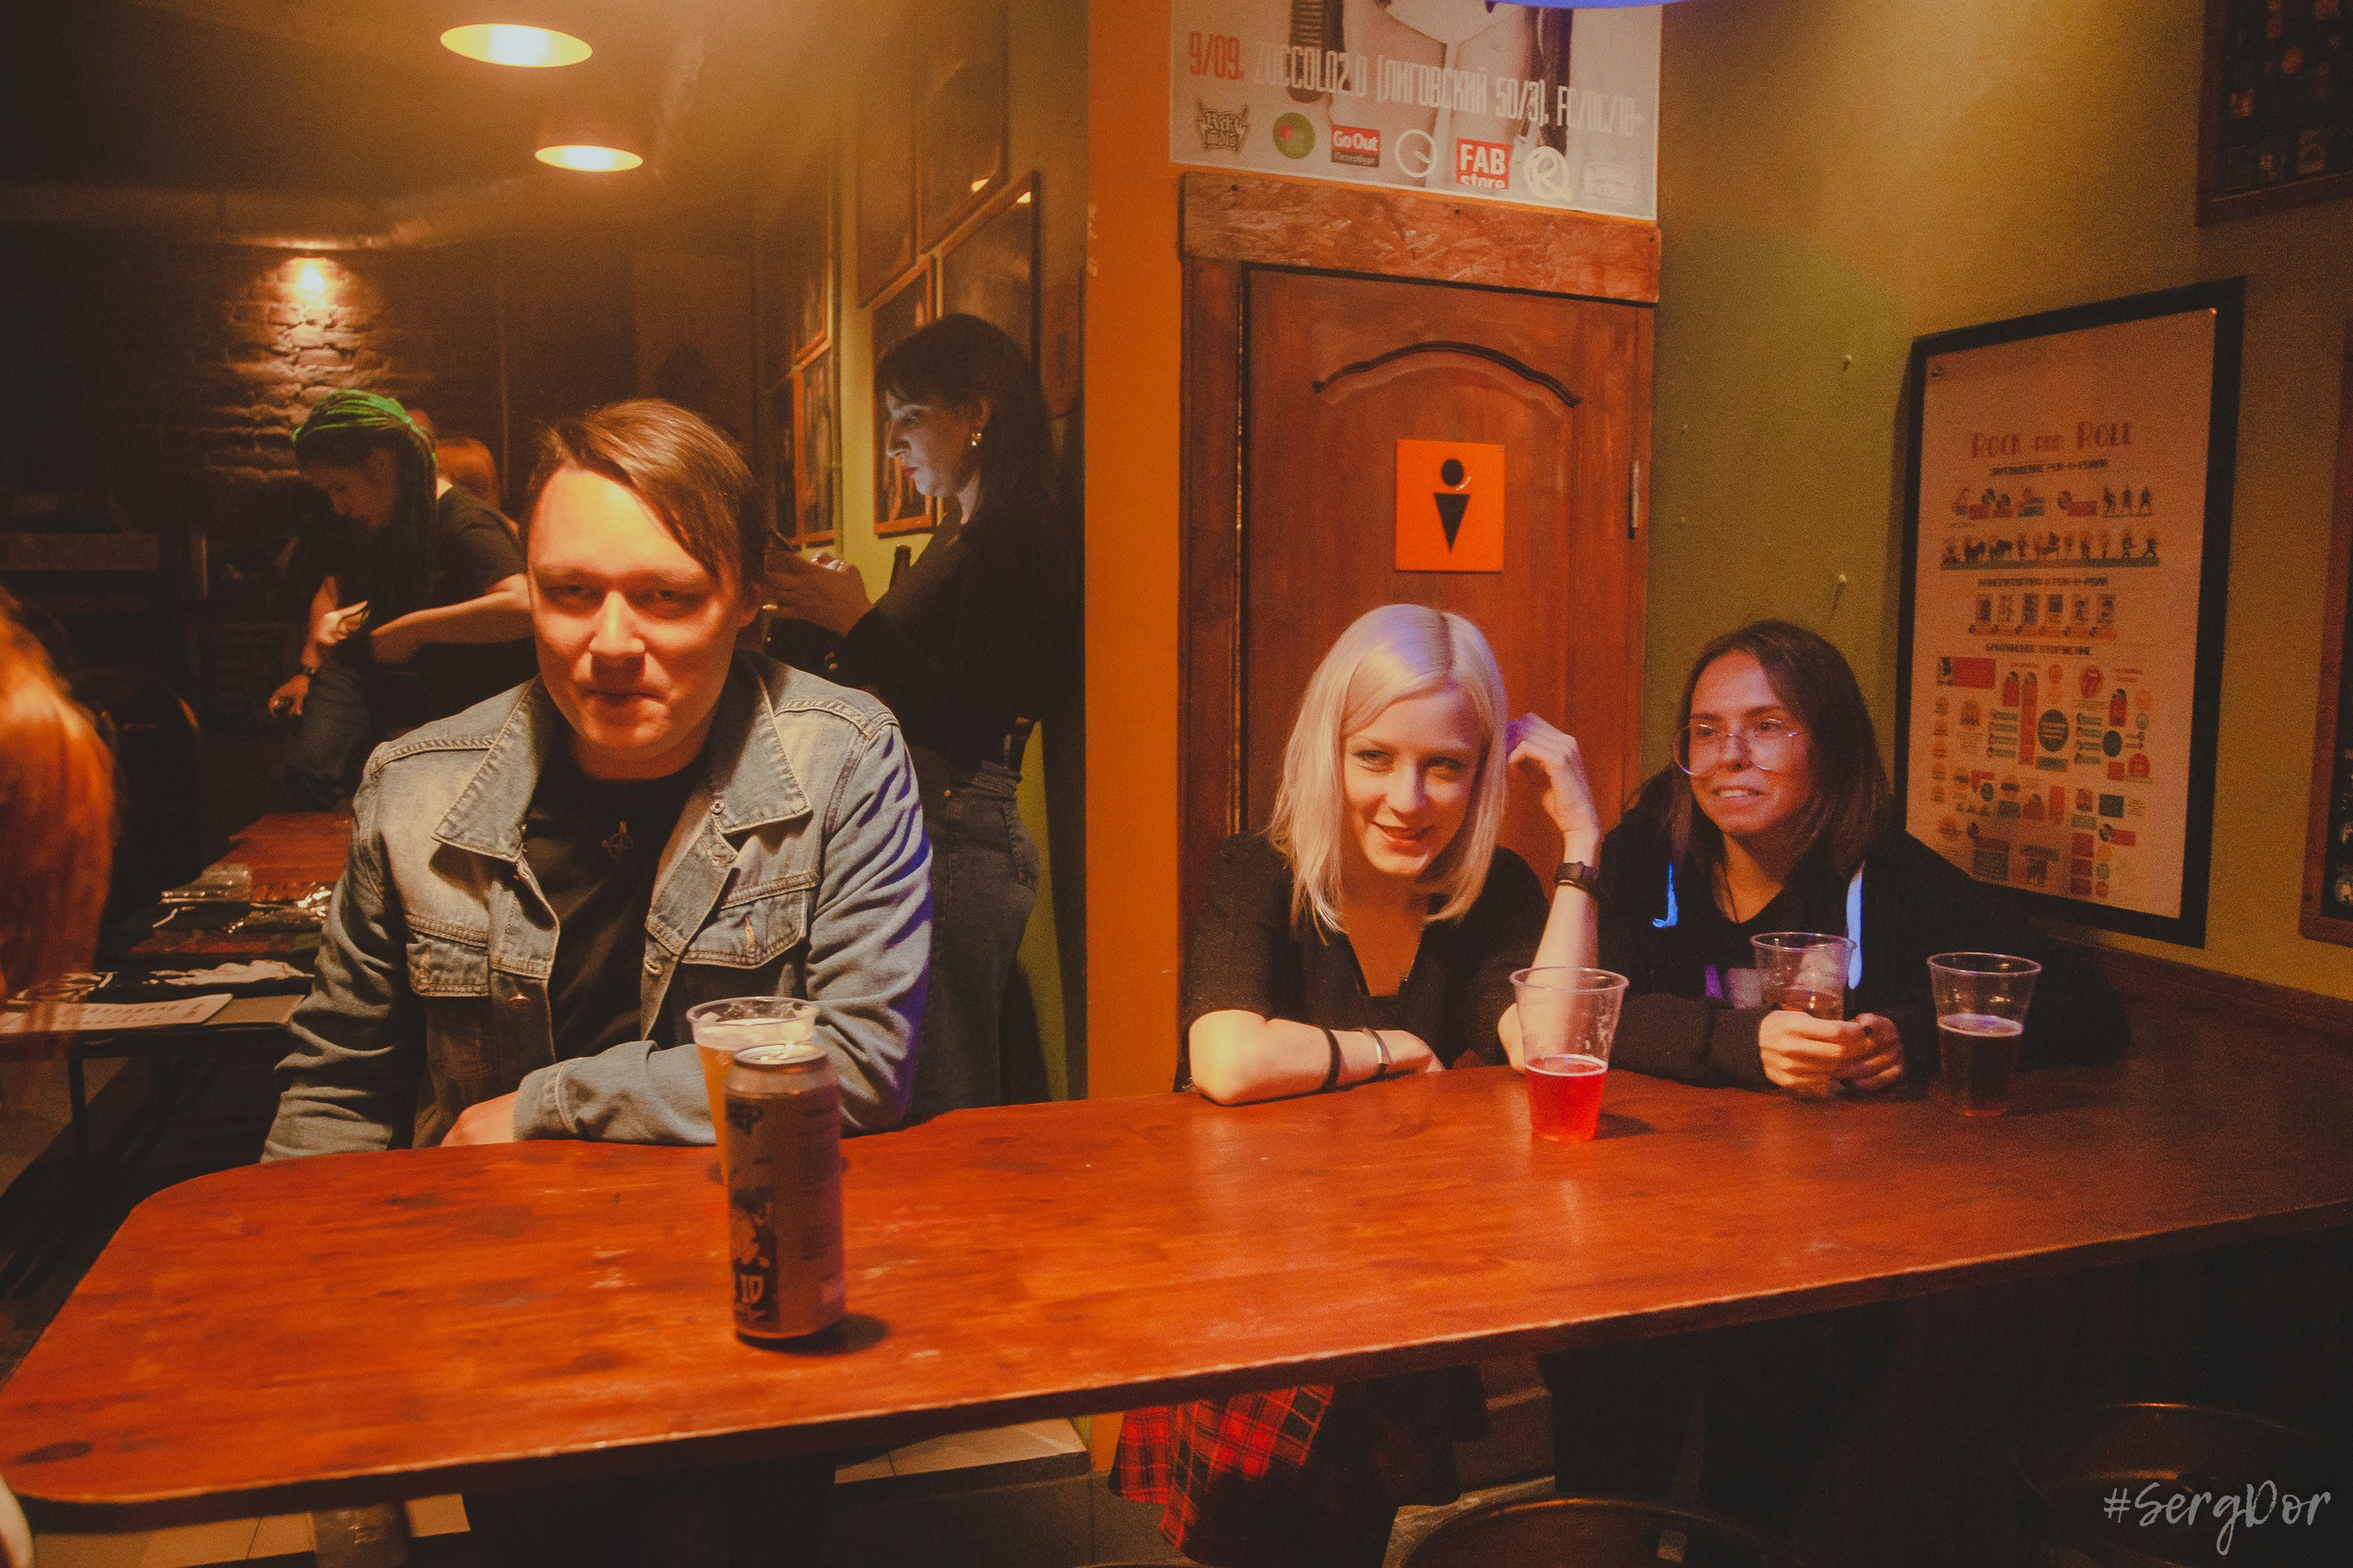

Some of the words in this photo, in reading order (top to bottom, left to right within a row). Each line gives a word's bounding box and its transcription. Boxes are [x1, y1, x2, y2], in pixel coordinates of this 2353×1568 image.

[1189, 31, 1245, 81] 9/09.
[1333, 130, 1351, 148] Go
[1353, 132, 1379, 152] Out
[1461, 144, 1506, 176] FAB
